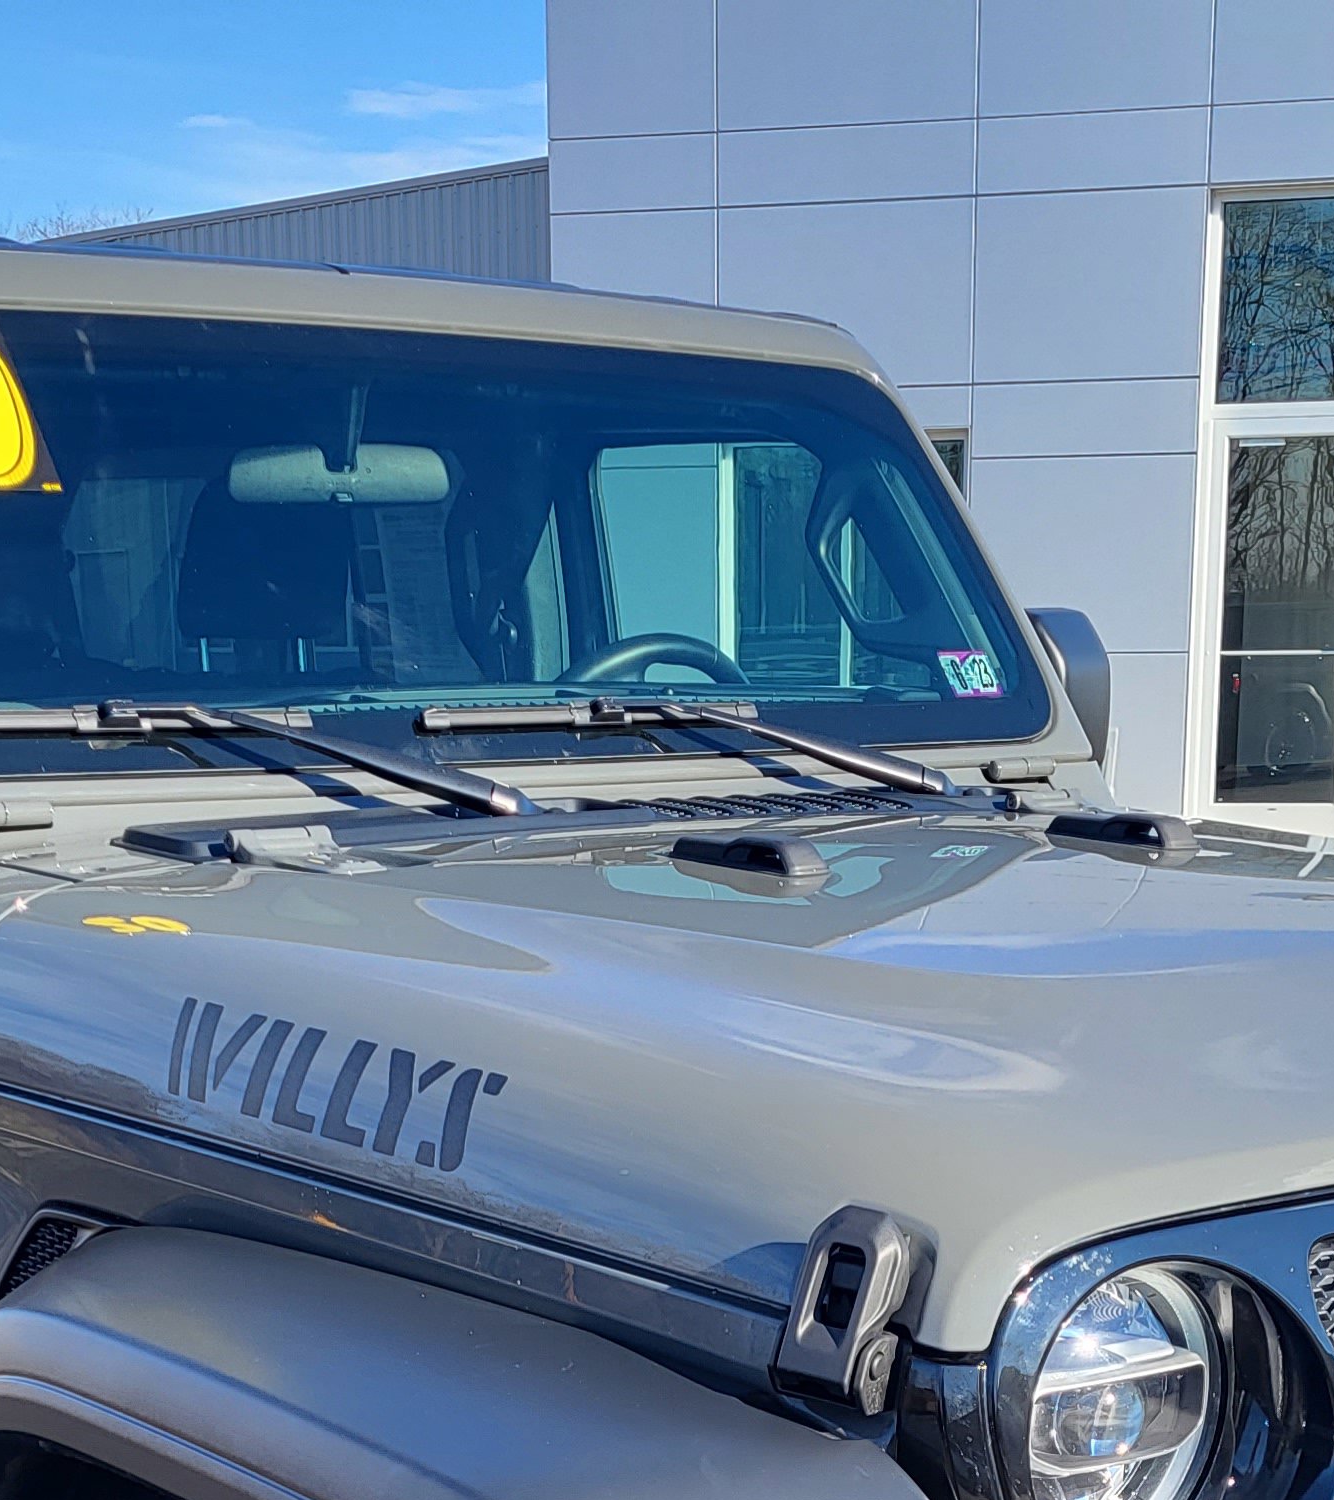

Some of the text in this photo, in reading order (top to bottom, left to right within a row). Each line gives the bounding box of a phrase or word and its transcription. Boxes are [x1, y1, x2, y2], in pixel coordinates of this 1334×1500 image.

[950, 657, 994, 690] 6 23
[168, 997, 508, 1172] WILLYS
